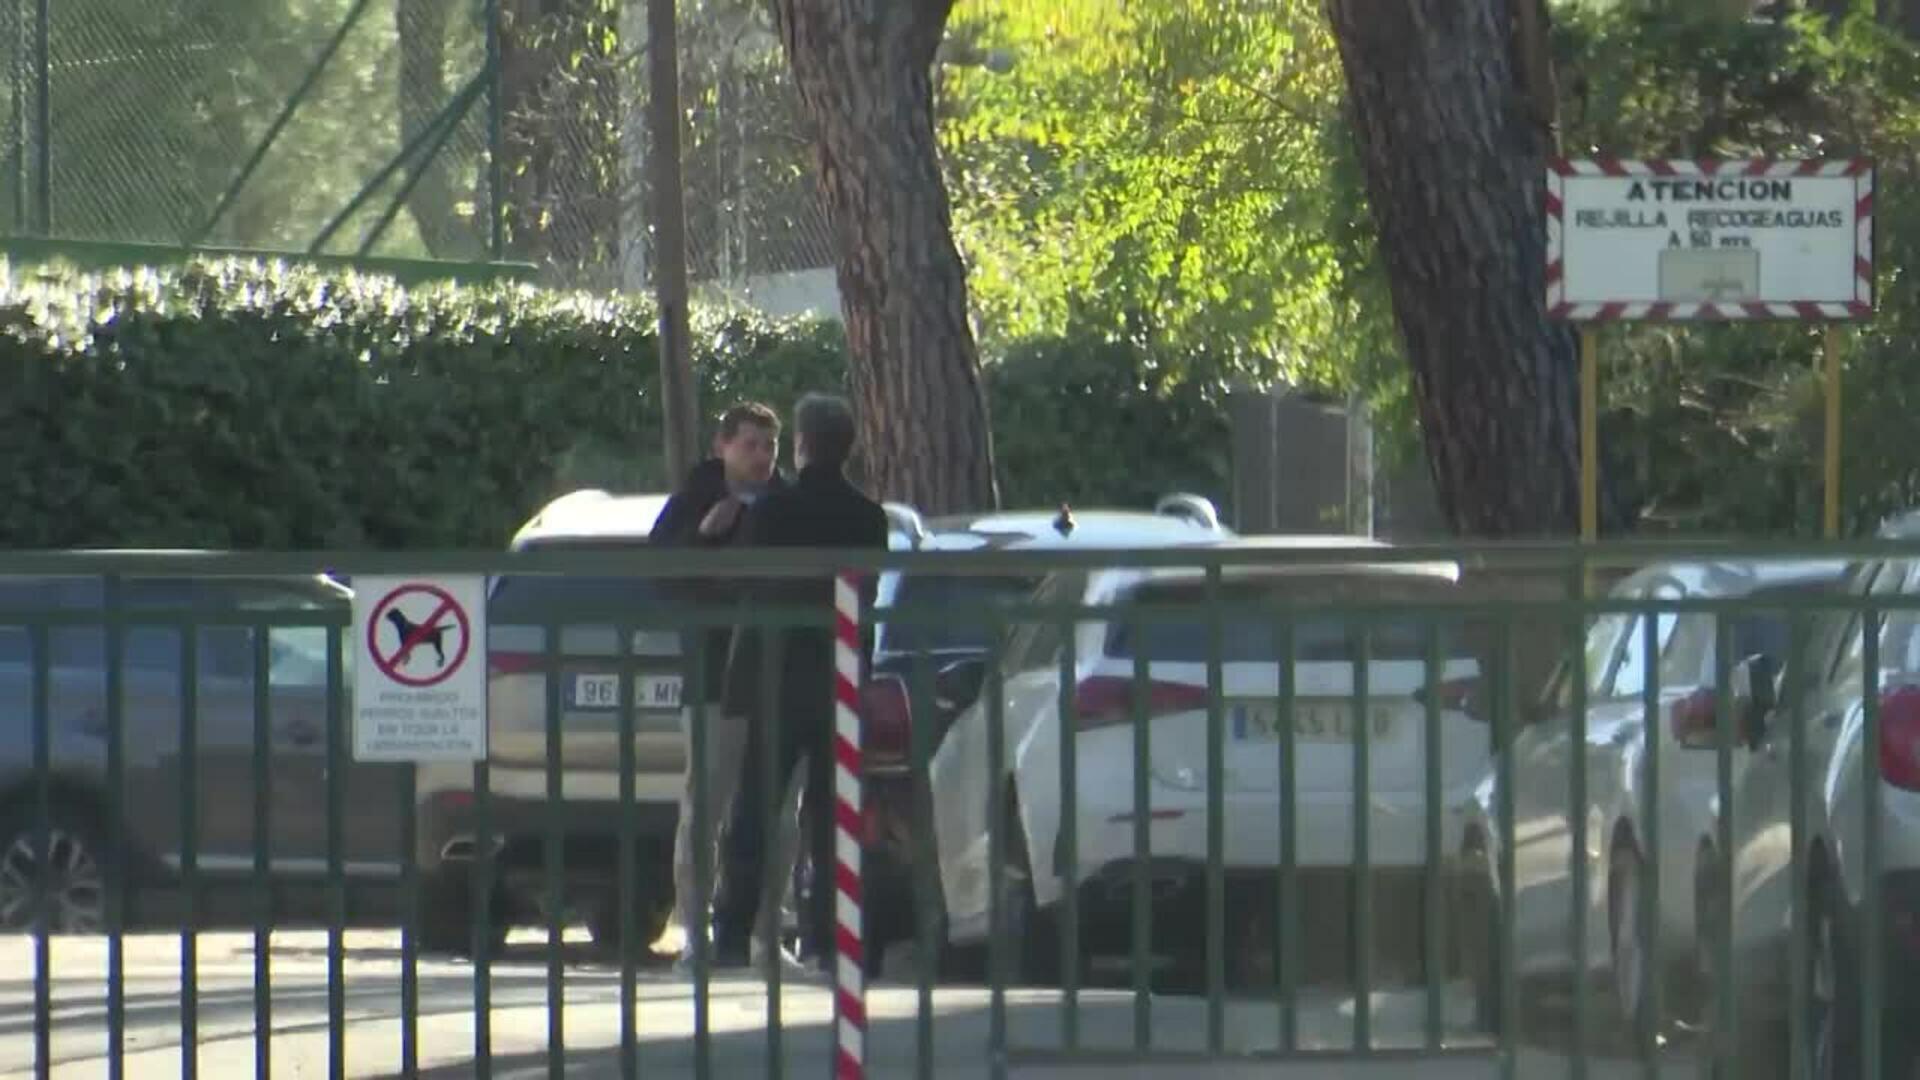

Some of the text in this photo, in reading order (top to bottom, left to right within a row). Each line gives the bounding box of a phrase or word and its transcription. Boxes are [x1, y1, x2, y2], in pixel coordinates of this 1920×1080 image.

[1627, 179, 1792, 201] ATENCION
[1687, 209, 1843, 229] RECOGEAGUAS
[1667, 231, 1681, 248] A
